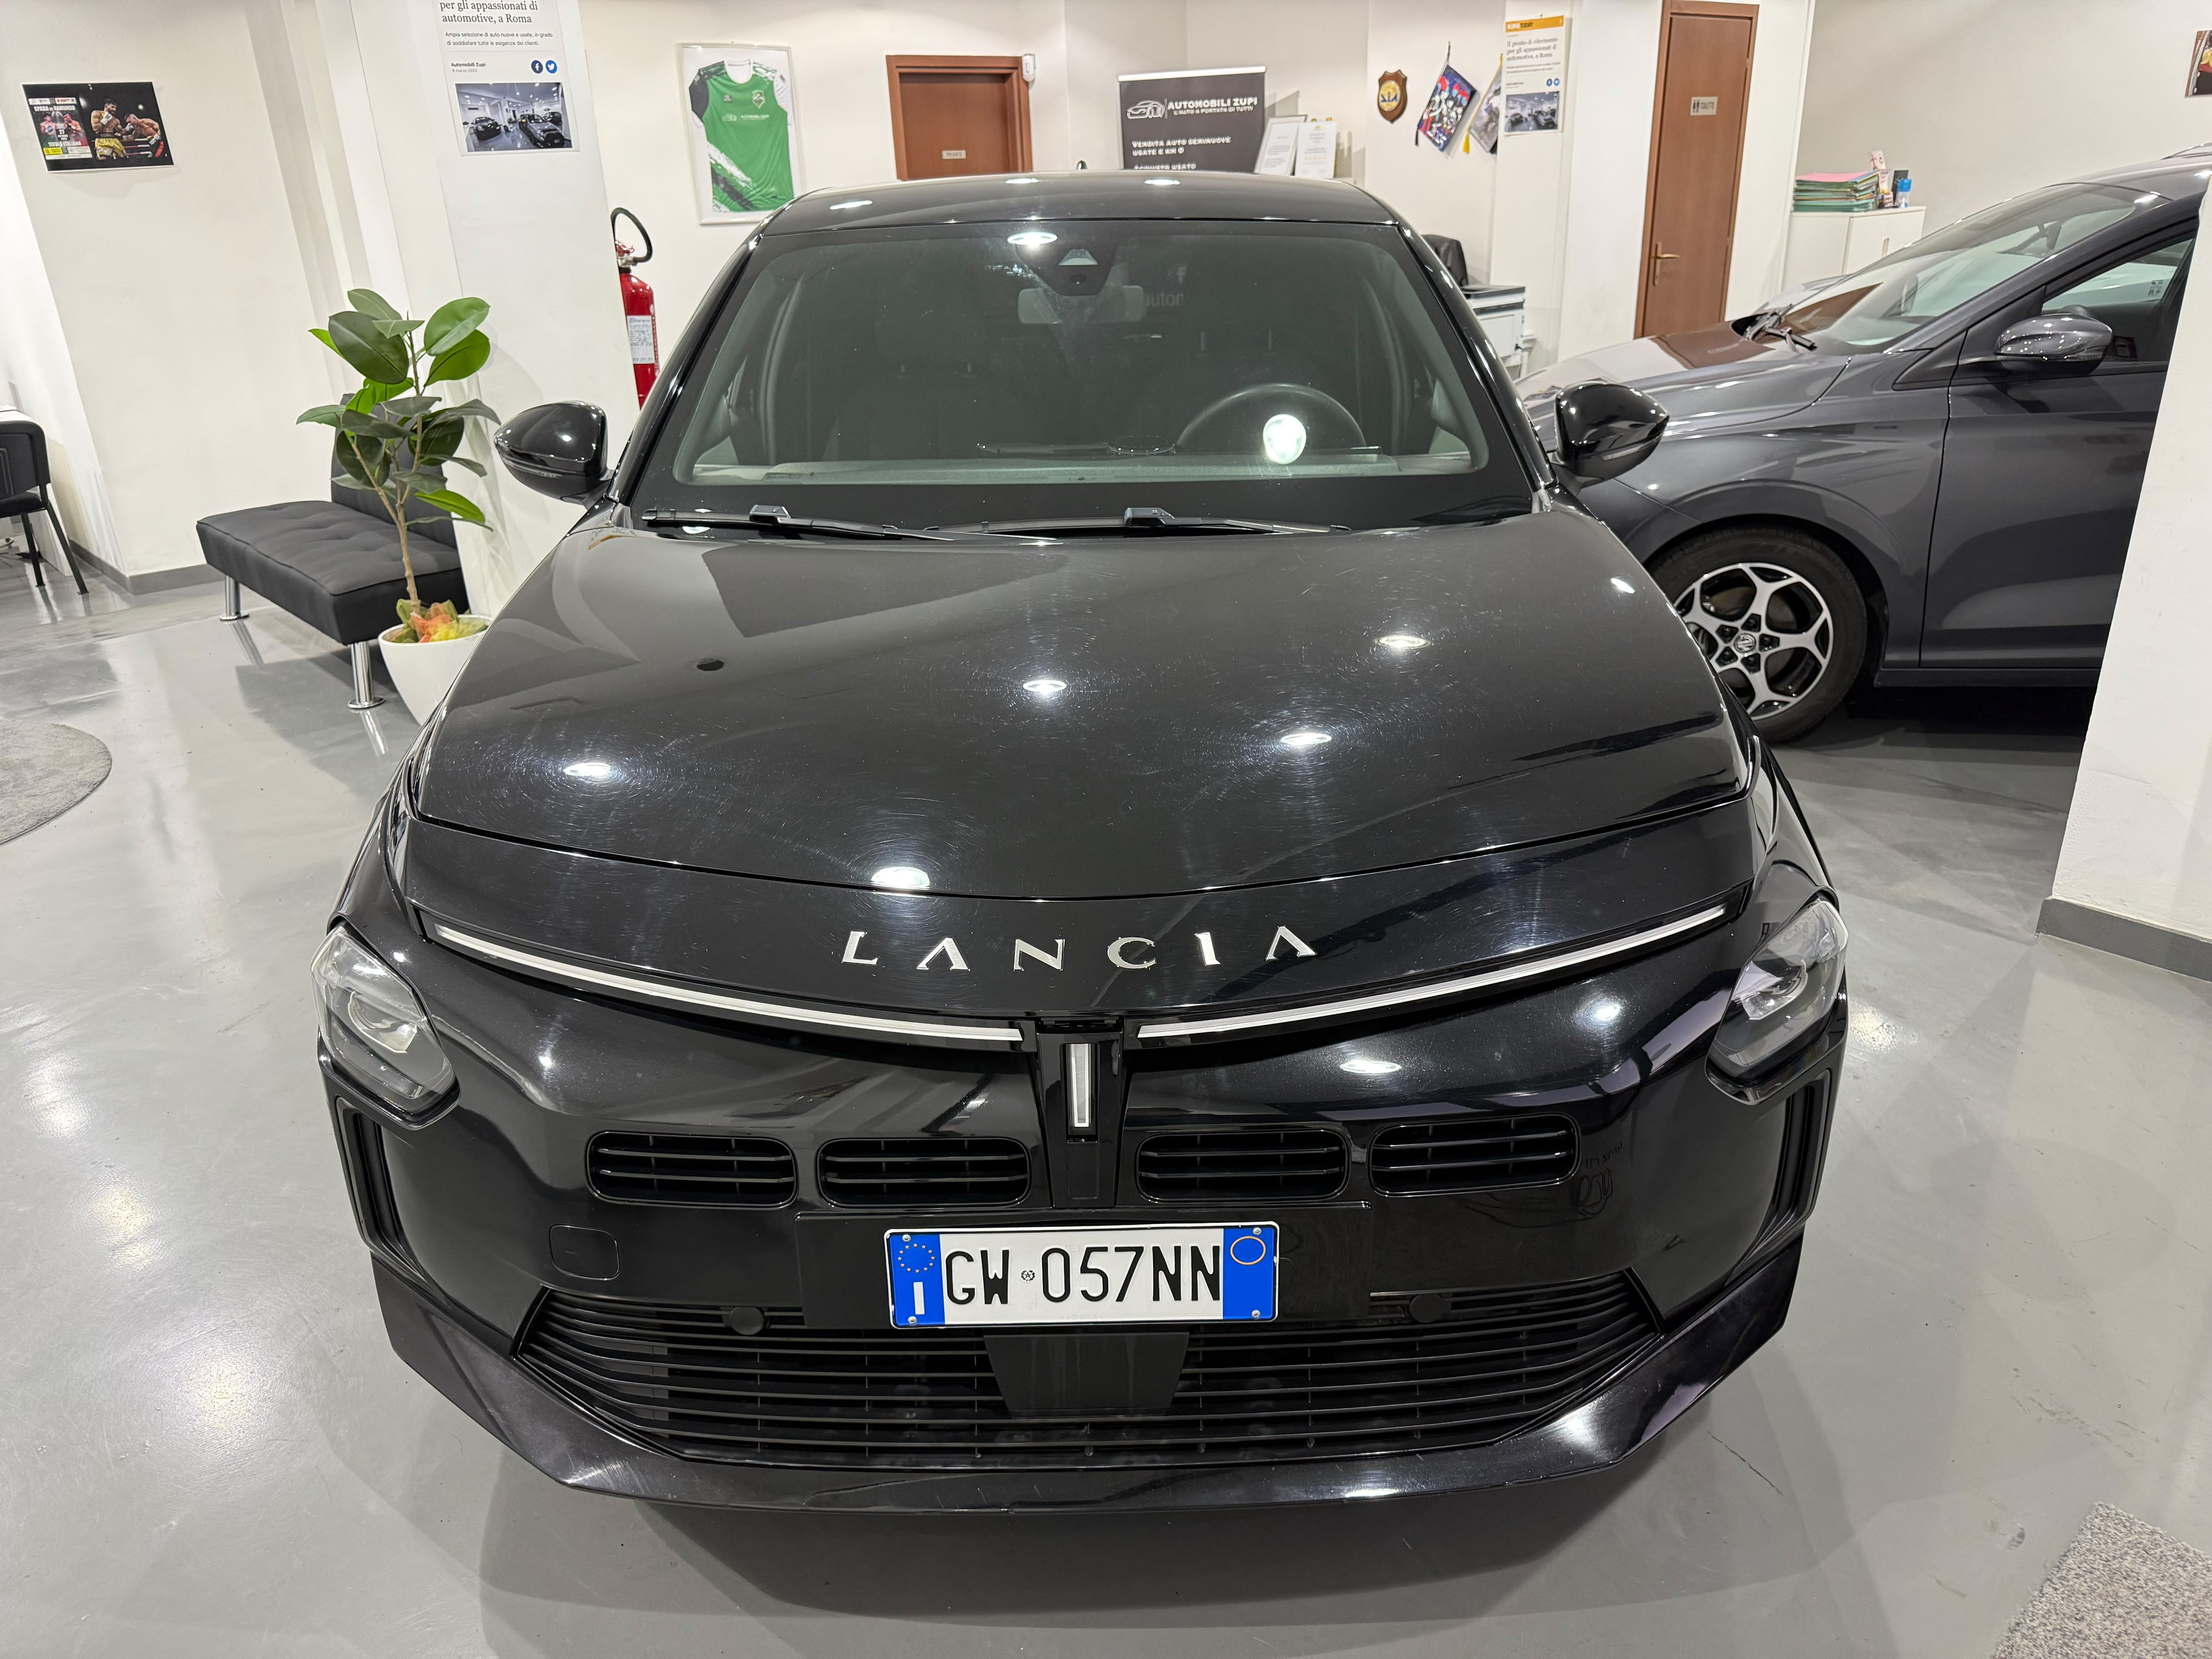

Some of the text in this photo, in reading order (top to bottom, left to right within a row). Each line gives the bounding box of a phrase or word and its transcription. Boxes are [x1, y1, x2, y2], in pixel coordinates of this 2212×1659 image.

[439, 0, 538, 12] per gli appassionati di
[442, 13, 496, 24] automotive,
[505, 14, 532, 23] Roma
[1167, 96, 1258, 110] AUTOMOBILI ZUPI
[1131, 139, 1164, 148] VENDITA
[841, 925, 1317, 971] LANCIA
[945, 1249, 1010, 1305] GW
[1041, 1245, 1220, 1303] 057NN
